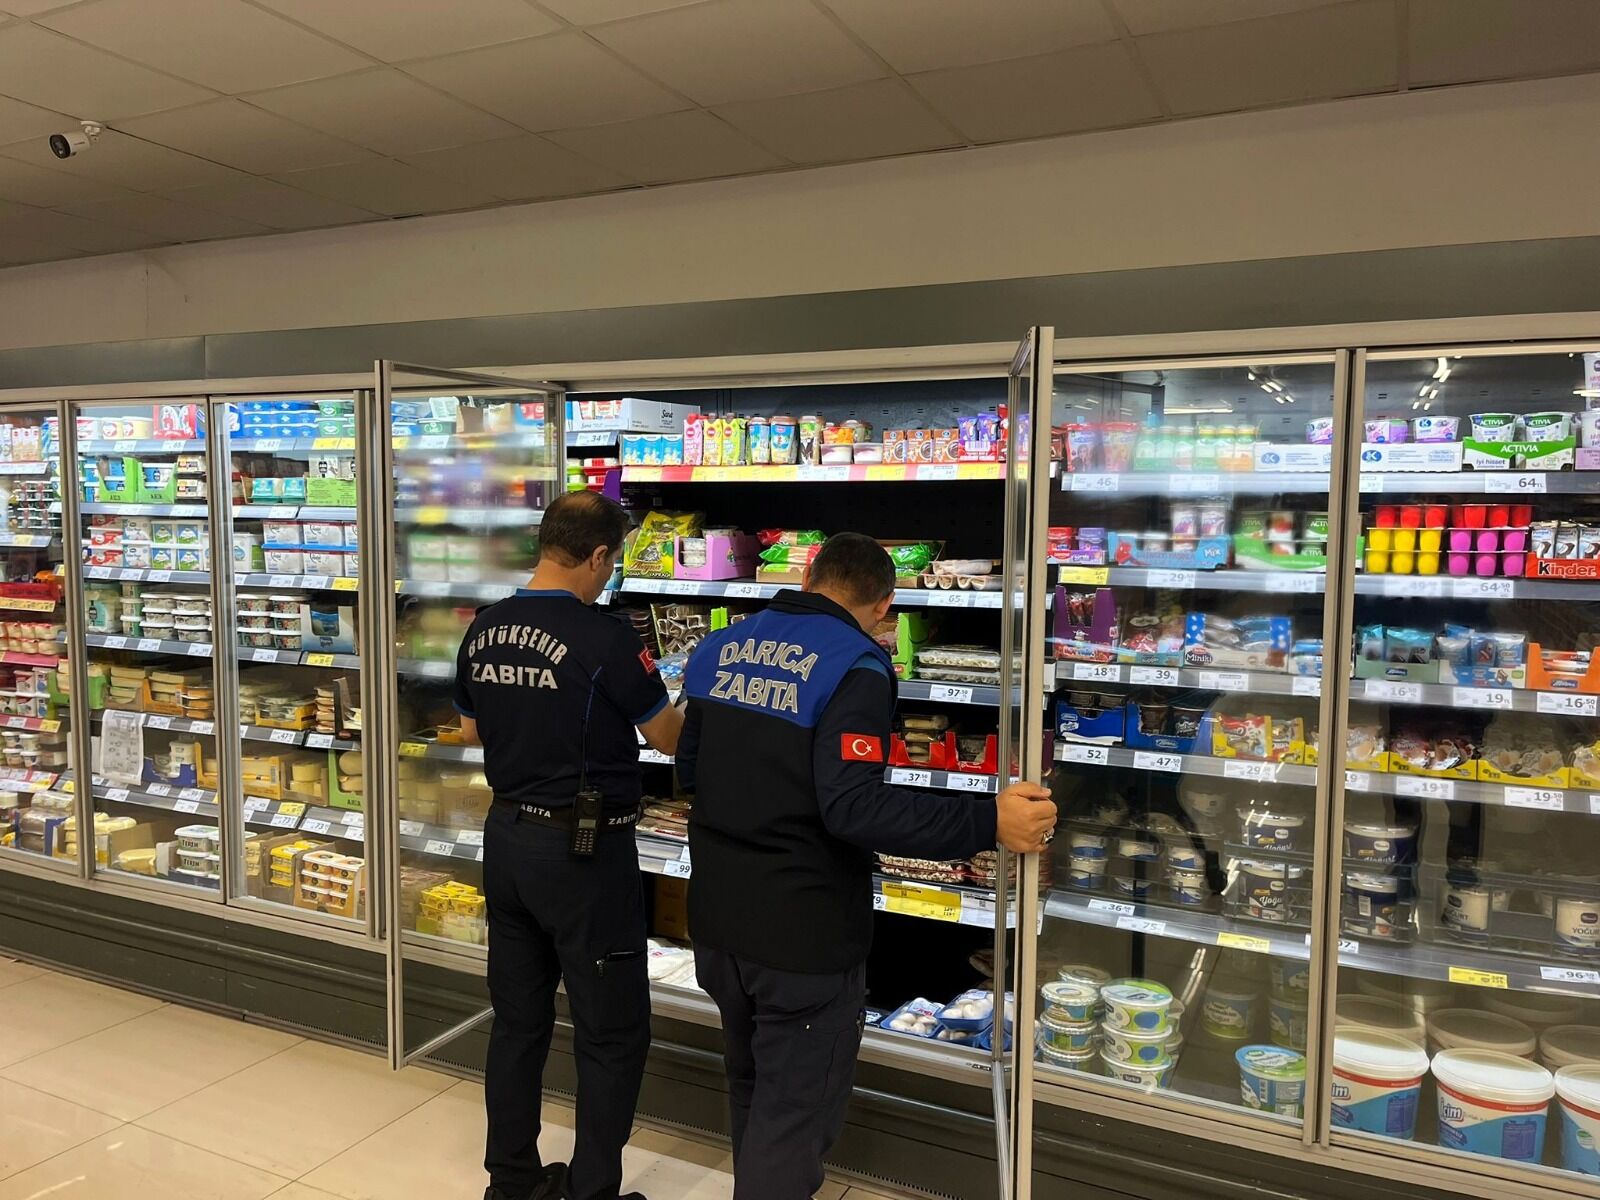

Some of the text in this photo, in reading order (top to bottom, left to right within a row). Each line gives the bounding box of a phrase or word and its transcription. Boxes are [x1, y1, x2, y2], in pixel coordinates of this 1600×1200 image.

[1500, 444, 1539, 453] ACTIVIA
[468, 624, 568, 665] BÜYÜKŞEHİR
[718, 638, 819, 682] DARICA
[471, 662, 559, 690] ZABITA
[709, 670, 798, 714] ZABITA
[520, 803, 551, 818] ABITA
